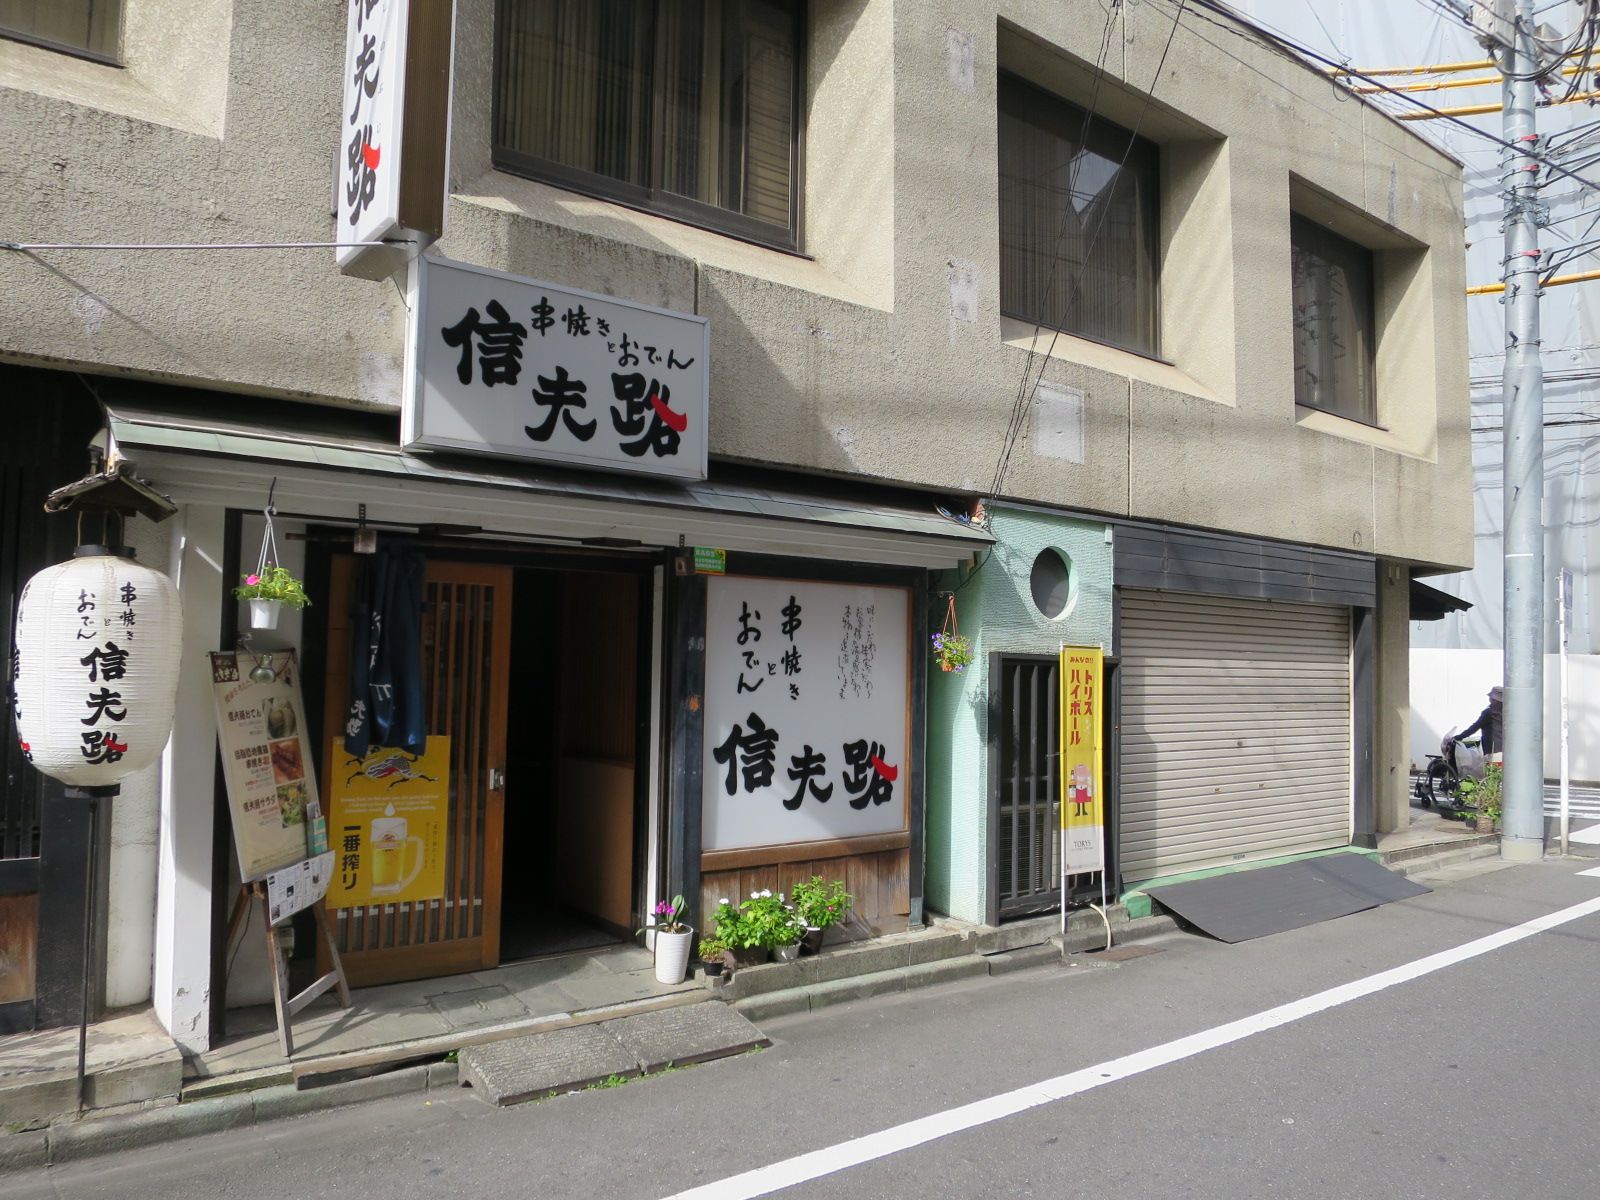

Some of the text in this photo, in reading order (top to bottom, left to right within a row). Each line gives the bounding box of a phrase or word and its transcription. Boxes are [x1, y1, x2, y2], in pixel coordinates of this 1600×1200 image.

[736, 601, 763, 695] おでん
[80, 641, 129, 764] 信夫路
[1069, 669, 1081, 745] ハイボール
[1084, 669, 1093, 716] トリス
[712, 712, 898, 811] 信夫路
[342, 825, 361, 890] 一番搾り
